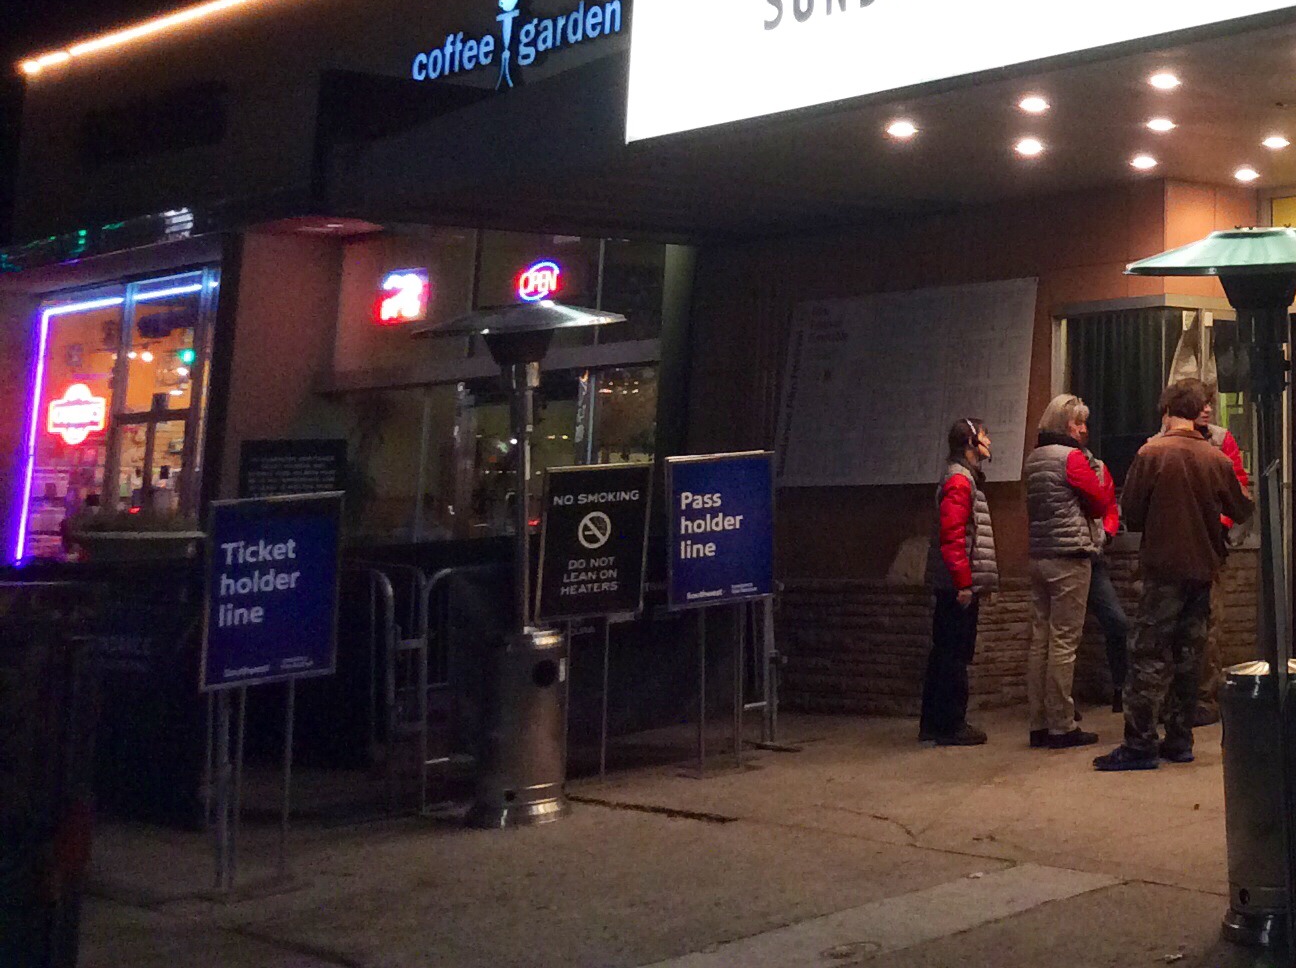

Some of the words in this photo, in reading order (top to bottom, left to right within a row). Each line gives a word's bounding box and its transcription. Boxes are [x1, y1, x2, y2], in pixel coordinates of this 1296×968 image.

[412, 31, 495, 81] coffee
[518, 0, 622, 66] garden
[519, 270, 559, 295] OPEN
[553, 495, 573, 507] NO
[577, 489, 640, 504] SMOKING
[680, 492, 722, 510] Pass
[680, 514, 743, 534] holder
[221, 538, 297, 565] Ticket
[680, 540, 716, 559] line
[567, 559, 586, 571] DO
[590, 556, 615, 568] NOT
[219, 569, 301, 596] holder
[562, 571, 598, 583] LEAN
[600, 568, 618, 580] ON
[559, 581, 619, 596] HEATERS
[218, 603, 265, 627] line
